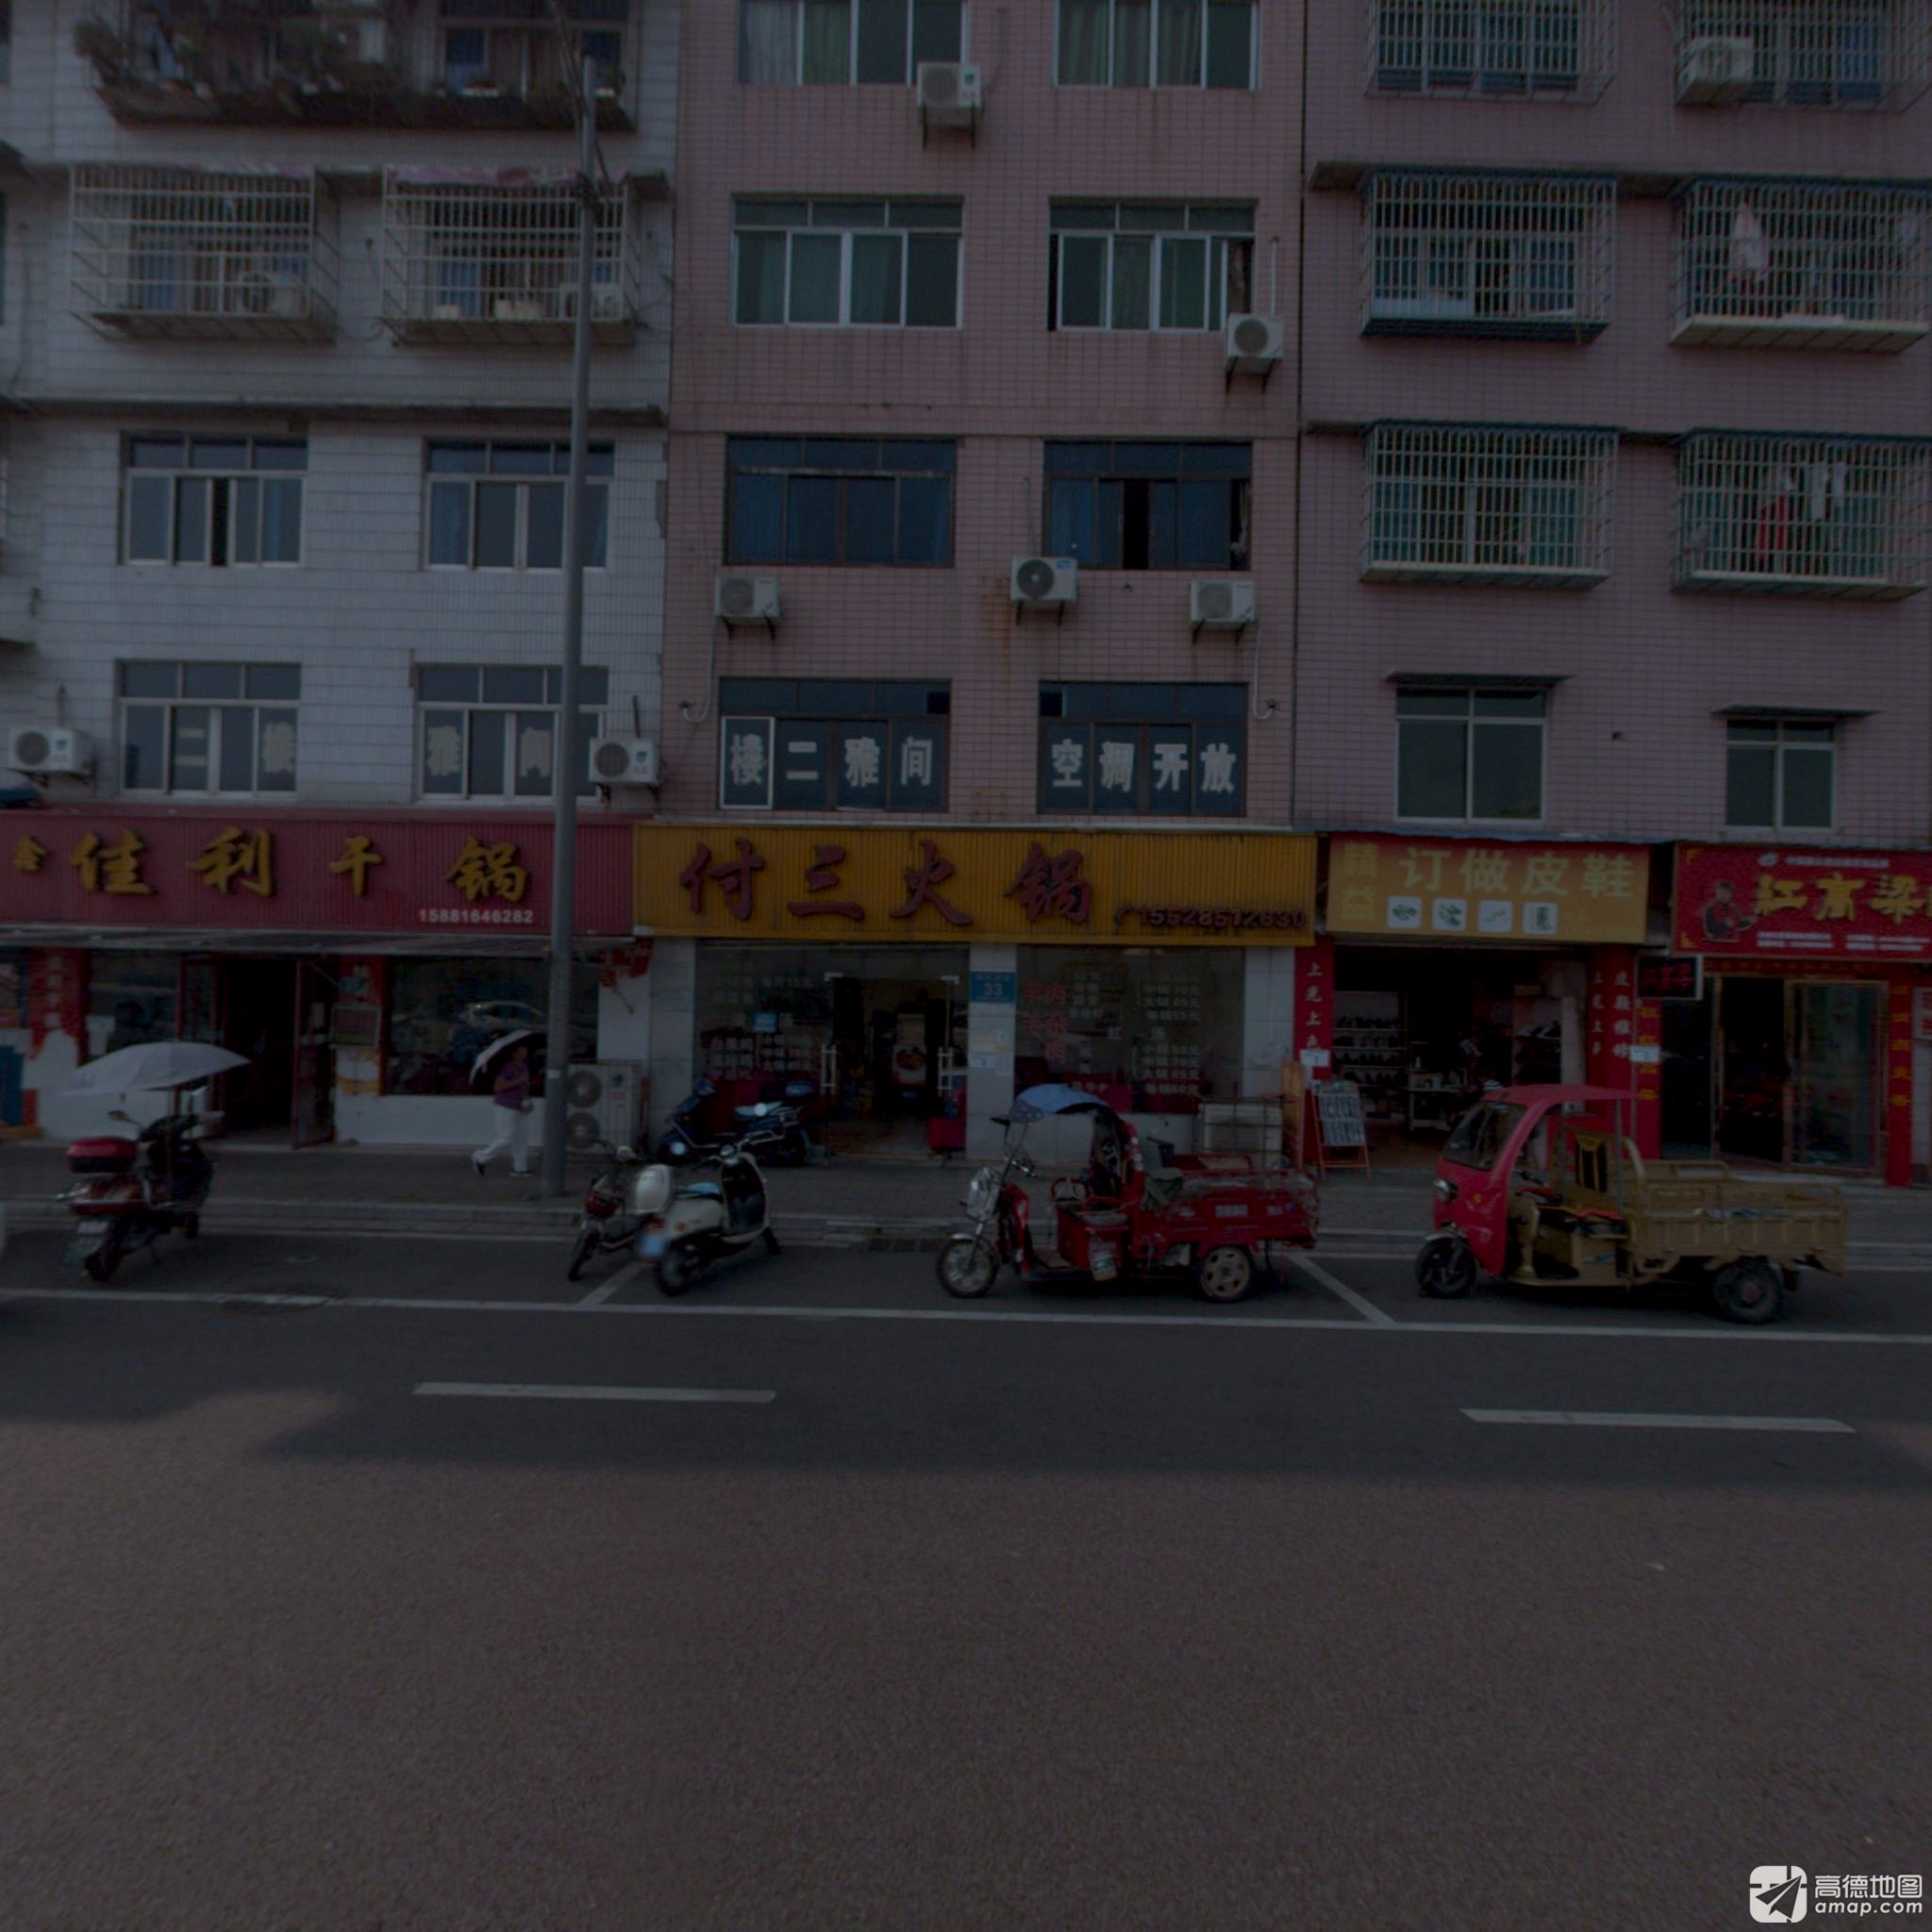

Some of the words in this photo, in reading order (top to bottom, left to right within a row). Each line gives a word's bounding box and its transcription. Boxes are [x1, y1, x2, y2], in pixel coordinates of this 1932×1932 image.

[1052, 738, 1237, 794] 空调开放
[680, 838, 1093, 925] 付三火锅
[1341, 841, 1379, 922] 精益
[1399, 846, 1637, 898] 订做皮鞋
[419, 908, 534, 924] 15881646282
